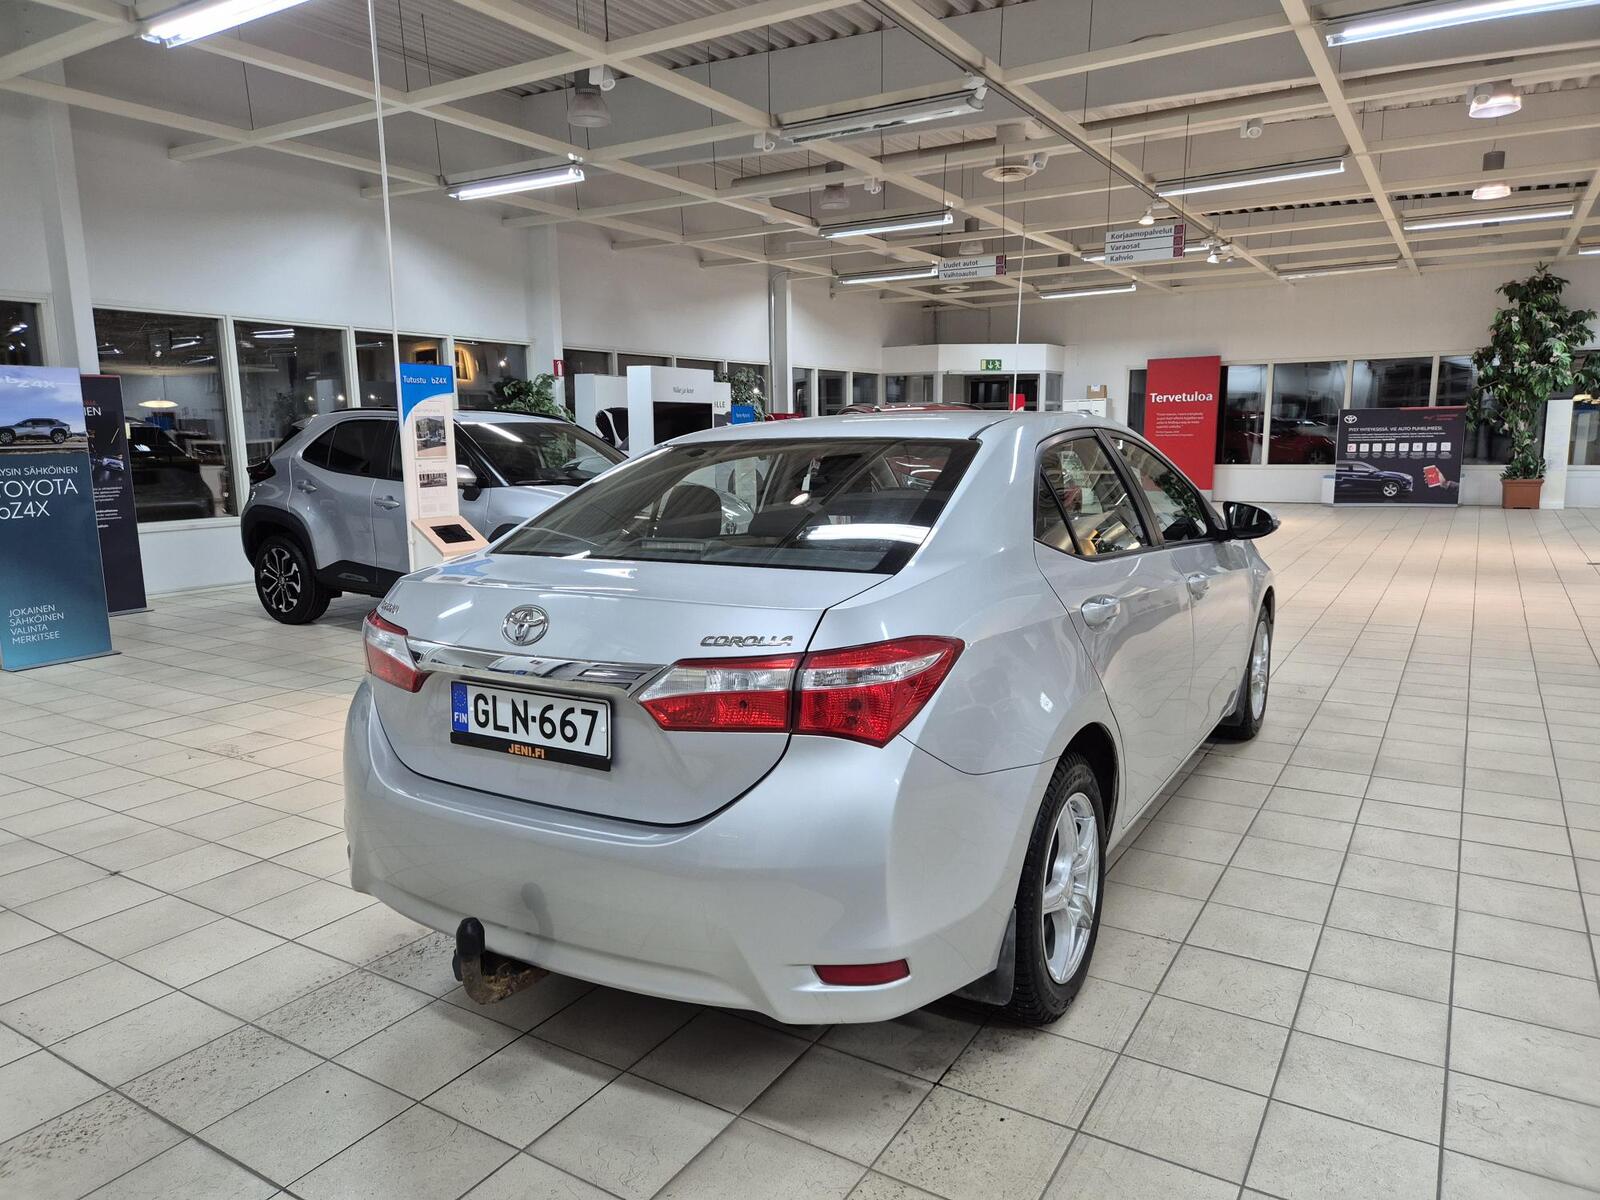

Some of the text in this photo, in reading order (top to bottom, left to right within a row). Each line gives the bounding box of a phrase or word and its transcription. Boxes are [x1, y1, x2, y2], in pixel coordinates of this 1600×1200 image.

[1110, 227, 1173, 240] Korjaamopalvelut
[1110, 242, 1140, 251] Varaosat
[1109, 254, 1133, 262] Kahvio
[943, 260, 961, 269] Uudet
[943, 270, 978, 278] Vaihtoautot
[402, 375, 447, 385] Tutustu bZ4X
[1149, 391, 1213, 403] Tervetuloa
[24, 465, 78, 476] SÄHKÖINEN
[9, 604, 56, 618] JOKAINEN
[10, 624, 48, 636] VALINTA
[12, 631, 61, 645] MERKITSEE
[700, 635, 793, 647] COROLLA
[454, 712, 468, 723] FIN
[473, 693, 599, 746] GLN-667
[508, 743, 545, 759] JENI.FI
